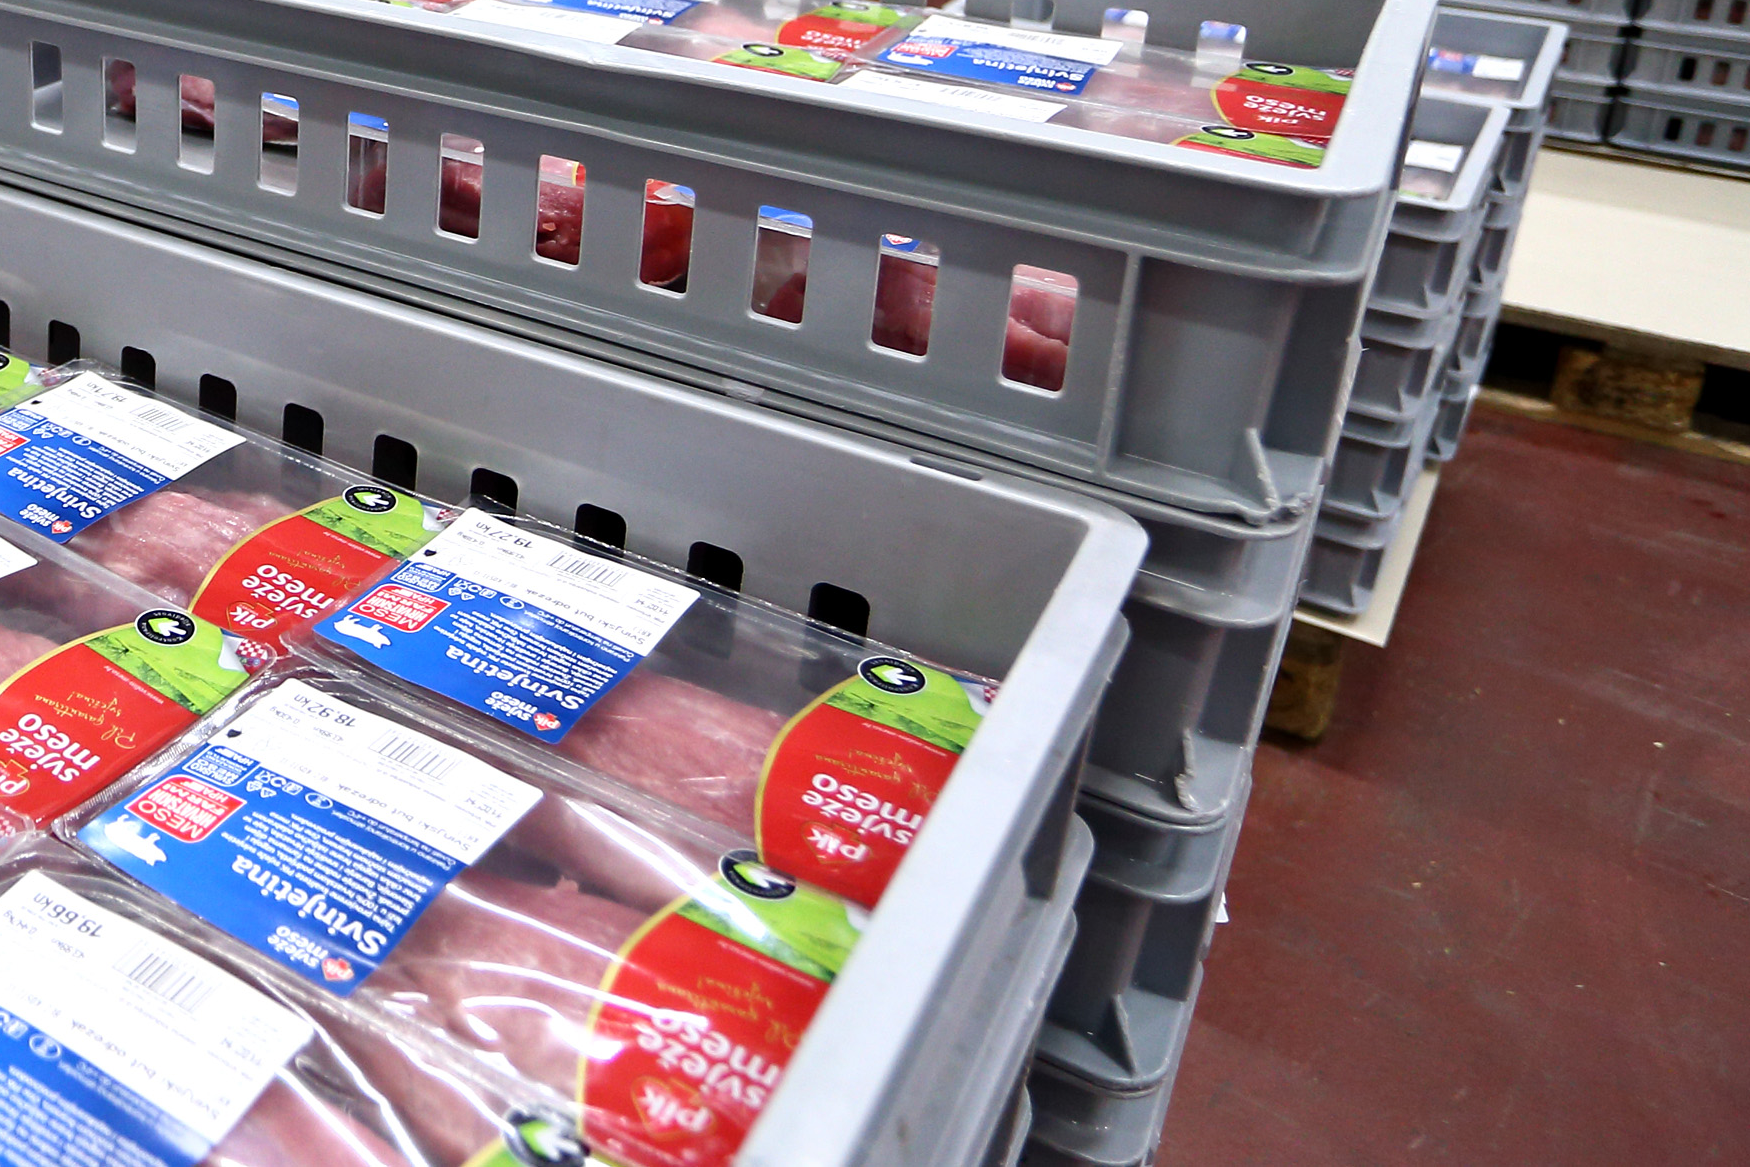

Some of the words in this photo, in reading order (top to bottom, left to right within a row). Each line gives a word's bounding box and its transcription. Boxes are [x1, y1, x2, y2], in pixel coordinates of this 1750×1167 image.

[973, 57, 1084, 81] Svinjetina
[1243, 100, 1326, 121] svježe
[1246, 95, 1326, 116] meso
[1258, 115, 1298, 124] pik
[7, 467, 102, 518] Svinjetina
[27, 504, 60, 522] meso
[476, 522, 491, 533] kn
[242, 576, 325, 618] svježe
[253, 565, 334, 609] meso
[526, 589, 571, 609] odrezak
[230, 606, 276, 628] pik
[359, 603, 418, 629] MESO
[366, 596, 428, 622] HRVATSKIH
[574, 609, 595, 621] but
[598, 619, 645, 645] Svinjski
[446, 645, 584, 709] Svinjetina
[28, 691, 109, 729] garantirana
[62, 688, 134, 719] svježina!
[294, 694, 311, 707] kn
[485, 696, 534, 721] svježe
[491, 692, 538, 714] meso
[95, 722, 149, 751] Pik
[534, 715, 560, 729] pik
[18, 714, 100, 770] meso
[148, 789, 217, 828] HRVATSKIH
[162, 783, 225, 816] FARMI
[339, 784, 387, 807] odrezak
[812, 774, 923, 829] meso
[138, 800, 203, 838] MESO
[391, 808, 414, 822] but
[802, 790, 915, 844] svježe
[418, 821, 469, 851] Svinjski
[808, 828, 867, 860] pik
[33, 893, 53, 911] kn
[232, 855, 393, 955] Svinjetina
[267, 934, 325, 968] svježe
[276, 926, 328, 961] meso
[636, 1026, 769, 1110] svježe
[640, 1086, 709, 1131] pik
